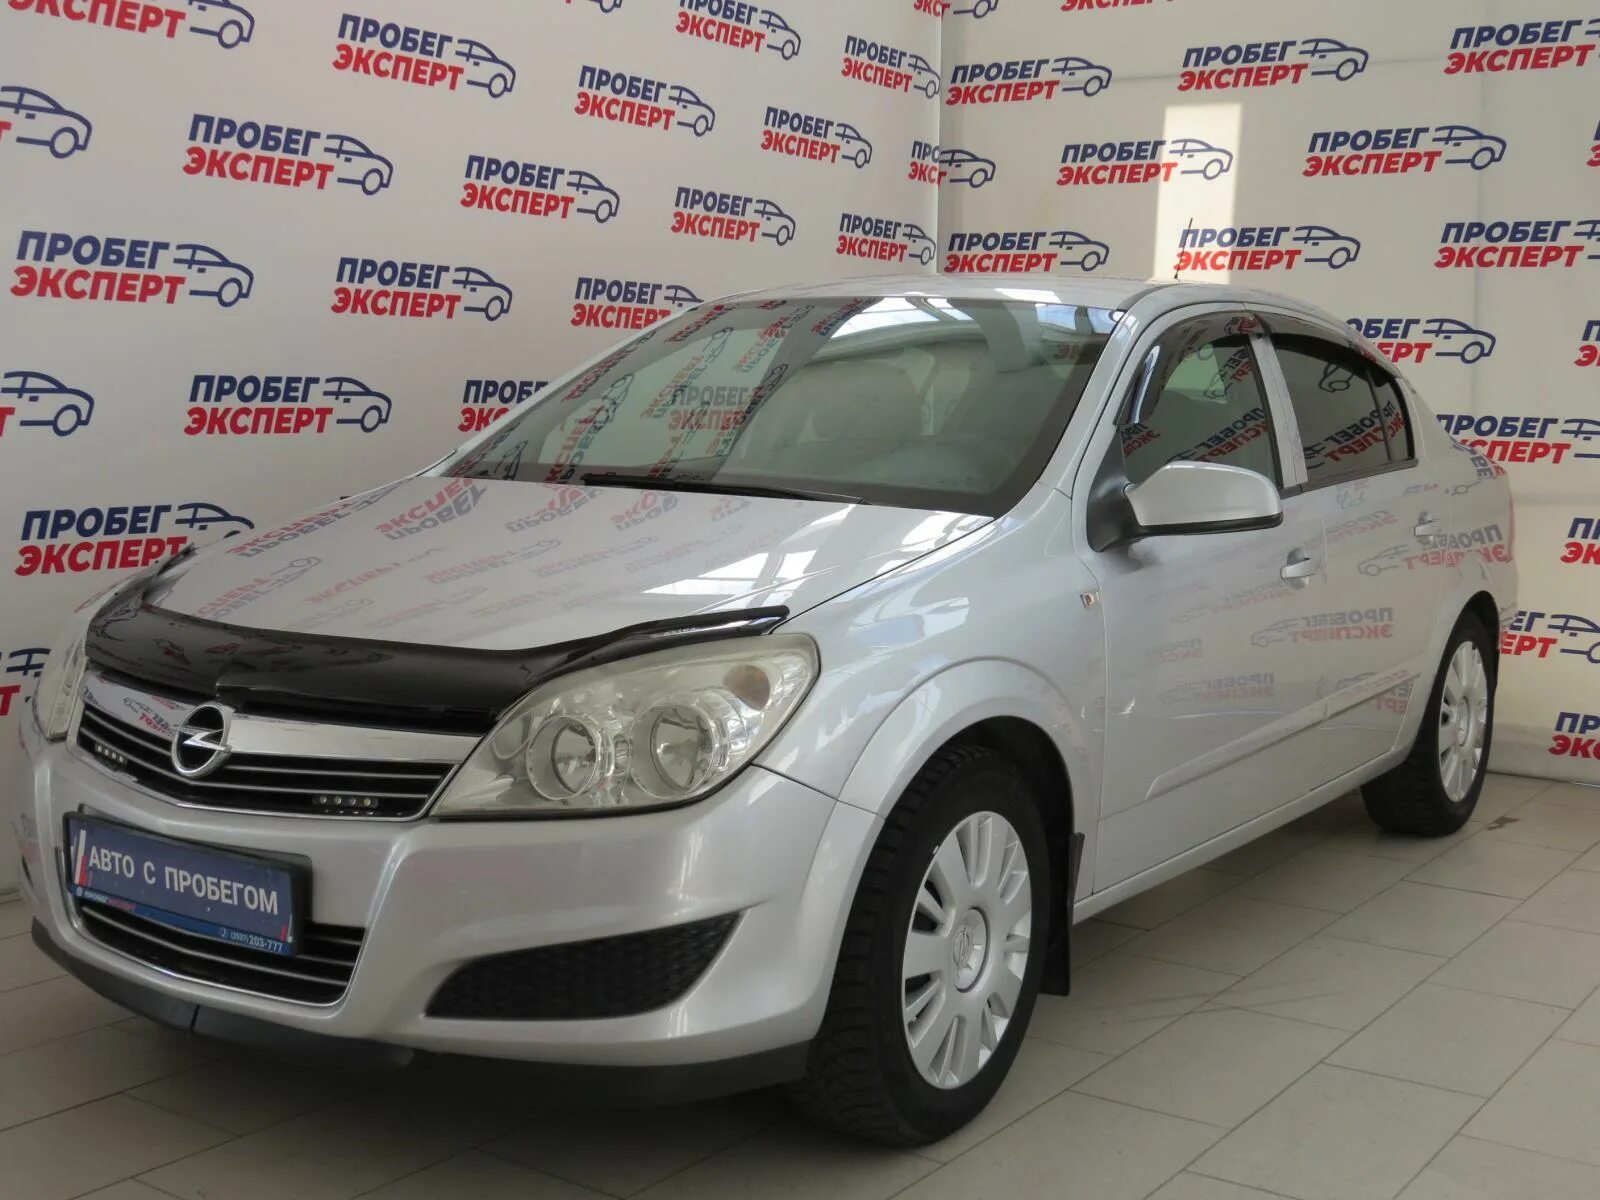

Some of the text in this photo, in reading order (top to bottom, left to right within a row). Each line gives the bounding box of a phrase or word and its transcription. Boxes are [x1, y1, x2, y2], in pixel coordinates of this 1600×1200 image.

[340, 13, 452, 58] ПРОБЕГ
[674, 11, 767, 53] ЭКСПЕРТ
[1450, 20, 1582, 49] ПРОБЕГ
[332, 43, 464, 91] ЭКСПЕРТ
[845, 36, 907, 68] ПРОБЕГ
[1182, 41, 1296, 67] ПРОБЕГ
[1444, 44, 1596, 75] ЭКСПЕРТ
[579, 65, 666, 103] ПРОБЕГ
[842, 57, 913, 92] ЭКСПЕРТ
[950, 57, 1049, 84] ПРОБЕГ
[1177, 63, 1308, 92] ЭКСПЕРТ
[946, 80, 1060, 106] ЭКСПЕРТ
[574, 91, 676, 130] ЭКСПЕРТ
[764, 107, 834, 139] ПРОБЕГ
[189, 114, 321, 156] ПРОБЕГ
[761, 129, 840, 163] ЭКСПЕРТ
[1308, 128, 1429, 153] ПРОБЕГ
[1061, 140, 1165, 164] ПРОБЕГ
[1302, 150, 1442, 177] ЭКСПЕРТ
[183, 146, 335, 190] ЭКСПЕРТ
[465, 154, 564, 191] ПРОБЕГ
[1055, 162, 1178, 186] ЭКСПЕРТ
[459, 182, 576, 220] ЭКСПЕРТ
[675, 187, 752, 217] ПРОБЕГ
[671, 211, 761, 246] ЭКСПЕРТ
[840, 213, 902, 239] ПРОБЕГ
[1179, 226, 1290, 248] ПРОБЕГ
[1441, 220, 1571, 244] ПРОБЕГ
[16, 231, 170, 269] ПРОБЕГ
[836, 234, 907, 262] ЭКСПЕРТ
[948, 231, 1046, 252] ПРОБЕГ
[946, 252, 1057, 273] ЭКСПЕРТ
[1173, 248, 1303, 272] ЭКСПЕРТ
[1435, 245, 1584, 269] ЭКСПЕРТ
[10, 265, 186, 305] ЭКСПЕРТ
[336, 257, 450, 289] ПРОБЕГ
[331, 287, 462, 319] ЭКСПЕРТ
[575, 277, 662, 304] ПРОБЕГ
[189, 375, 320, 403] ПРОБЕГ
[463, 380, 548, 404] ПРОБ
[184, 406, 333, 436] ЭКСПЕРТ
[21, 504, 172, 541] ПРОБЕГ
[88, 846, 135, 879] АВТО
[143, 862, 156, 885] С
[164, 867, 279, 916] ПРОБЕГОМ
[248, 934, 283, 953] 203-777
